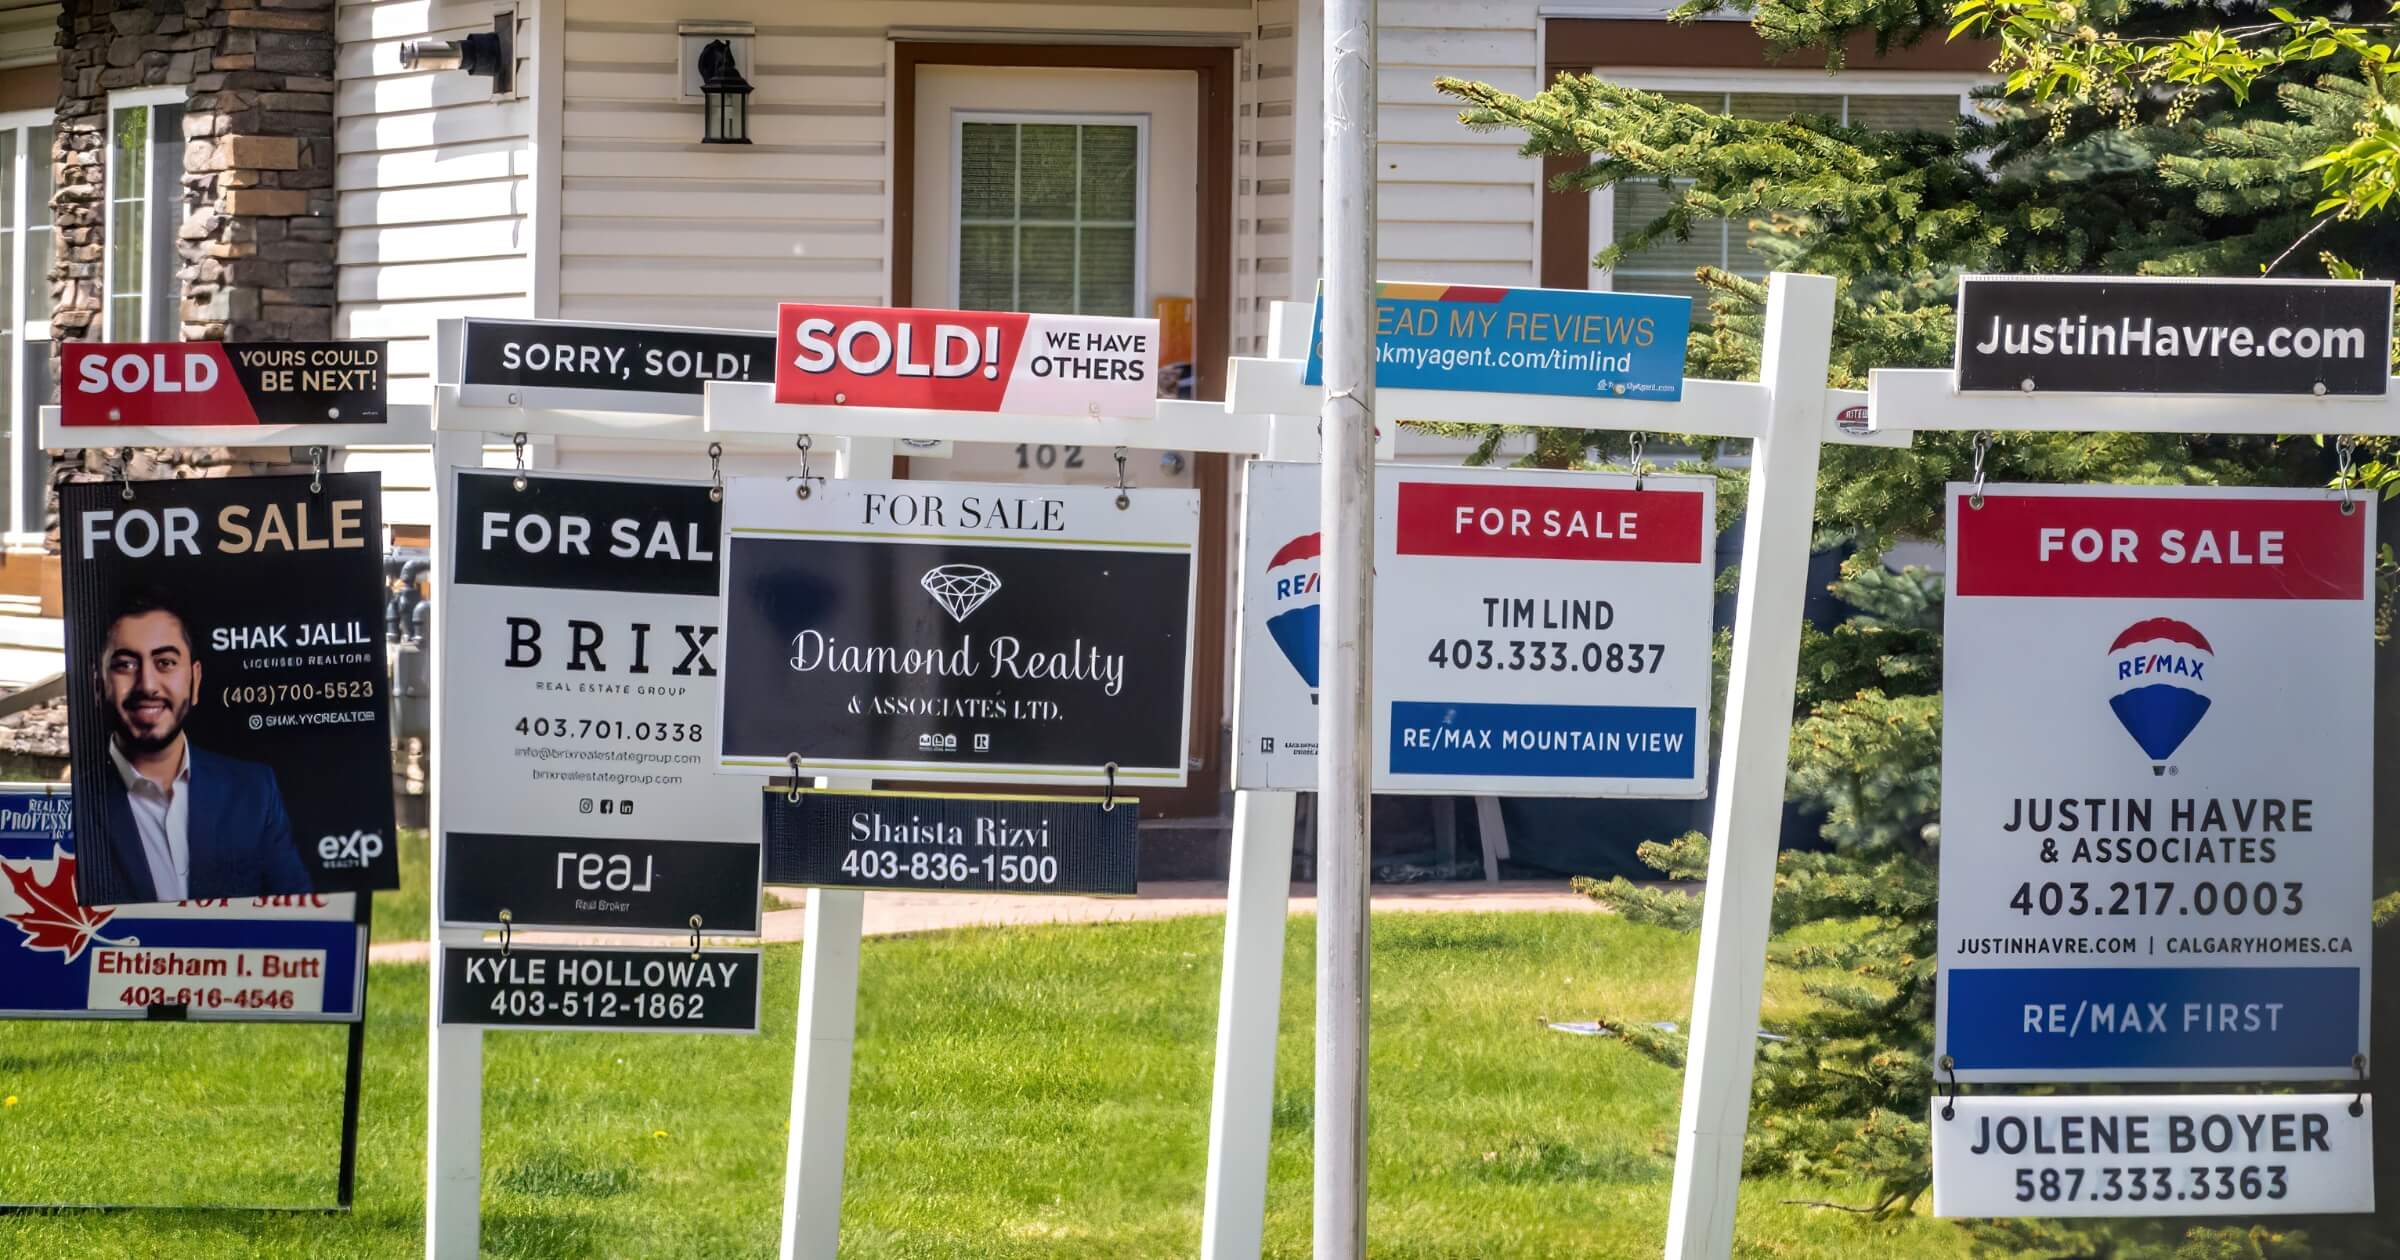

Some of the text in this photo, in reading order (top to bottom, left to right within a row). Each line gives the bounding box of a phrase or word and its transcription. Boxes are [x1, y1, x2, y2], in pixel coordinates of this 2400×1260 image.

[1376, 306, 1655, 348] EAD MY REVIEWS
[1977, 315, 2364, 358] JustinHavre.com
[503, 343, 751, 381] SORRY, SOLD!
[794, 319, 1146, 381] SOLD! WE HAVE
[1376, 342, 1632, 373] kmyagent.com/timlind
[79, 350, 378, 393] SOLD YOURS COULD
[262, 370, 376, 391] BE NEXT!
[1031, 356, 1144, 381] OTHERS
[1015, 443, 1085, 469] 102
[865, 494, 1064, 531] FOR SALE
[1456, 507, 1637, 539] FOR SALE
[82, 500, 364, 559] FOR SALE
[482, 512, 713, 561] FOR SAL
[2040, 528, 2283, 564] FOR SALE
[1277, 572, 1321, 601] RE/
[1483, 598, 1613, 630] TIM LIND
[213, 622, 370, 650] SHAK JALIL
[504, 616, 719, 677] BRIX
[790, 630, 1123, 696] Diamond Realty
[1429, 639, 1665, 673] 403.333.0837
[2118, 654, 2204, 681] RE/MAX
[223, 681, 373, 707] (403)700-5523
[536, 682, 685, 696] REAL ESTATE GROUP
[848, 695, 1062, 720] & ASSOCIATES LTD.
[515, 717, 702, 742] 403.701.0338
[1403, 727, 1685, 754] RE/MAX MOUNTAIN VIEW
[533, 769, 682, 784] brixrealestategroup.com
[852, 814, 1048, 847] Shaista Rizvi
[2003, 799, 2312, 832] JUSTIN HAVRE
[842, 850, 1057, 883] 403-836-1500
[2040, 838, 2276, 863] & ASSOCIATES
[2010, 882, 2303, 915] 403.217.0003
[1957, 937, 2137, 955] JUSTINHAVRE.COM
[2166, 937, 2353, 954] CALGARYHOMES.CA
[98, 951, 226, 976] Ehtisham
[263, 955, 319, 978] Butt
[465, 957, 739, 988] KYLE HOLLOWAY
[120, 986, 294, 1009] 403-616-4546
[491, 990, 703, 1018] 403-512-1862
[2023, 1000, 2285, 1038] RE/MAX FIRST
[1971, 1113, 2330, 1154] JOLENE BOYER
[2016, 1166, 2287, 1202] 587.333.3363
